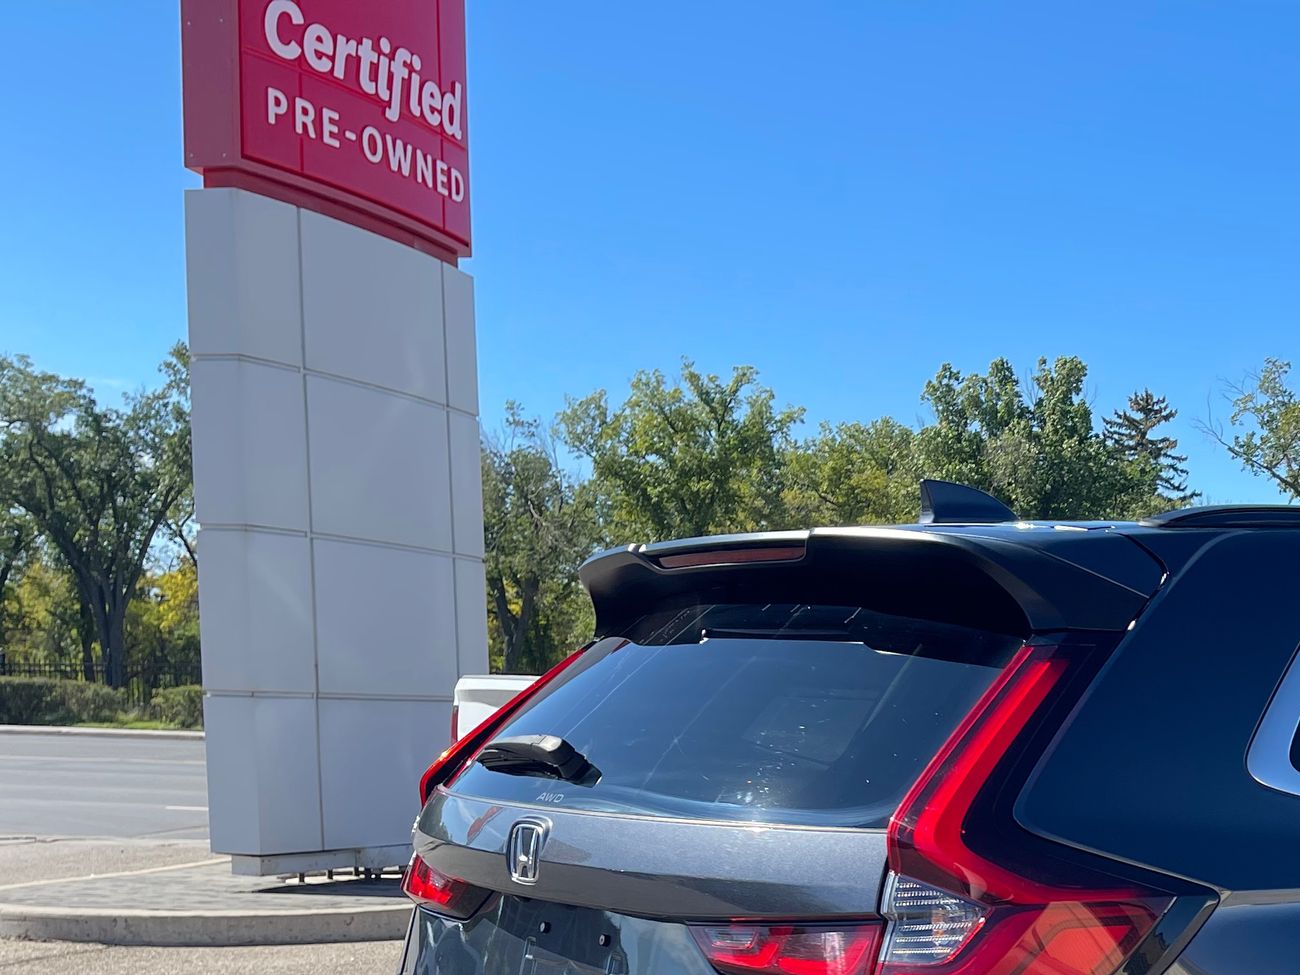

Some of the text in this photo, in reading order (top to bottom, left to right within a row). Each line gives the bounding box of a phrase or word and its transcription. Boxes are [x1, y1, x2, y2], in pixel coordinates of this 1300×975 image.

[264, 0, 462, 140] Certified
[267, 87, 465, 203] PRE-OWNED
[536, 792, 565, 803] AWD
